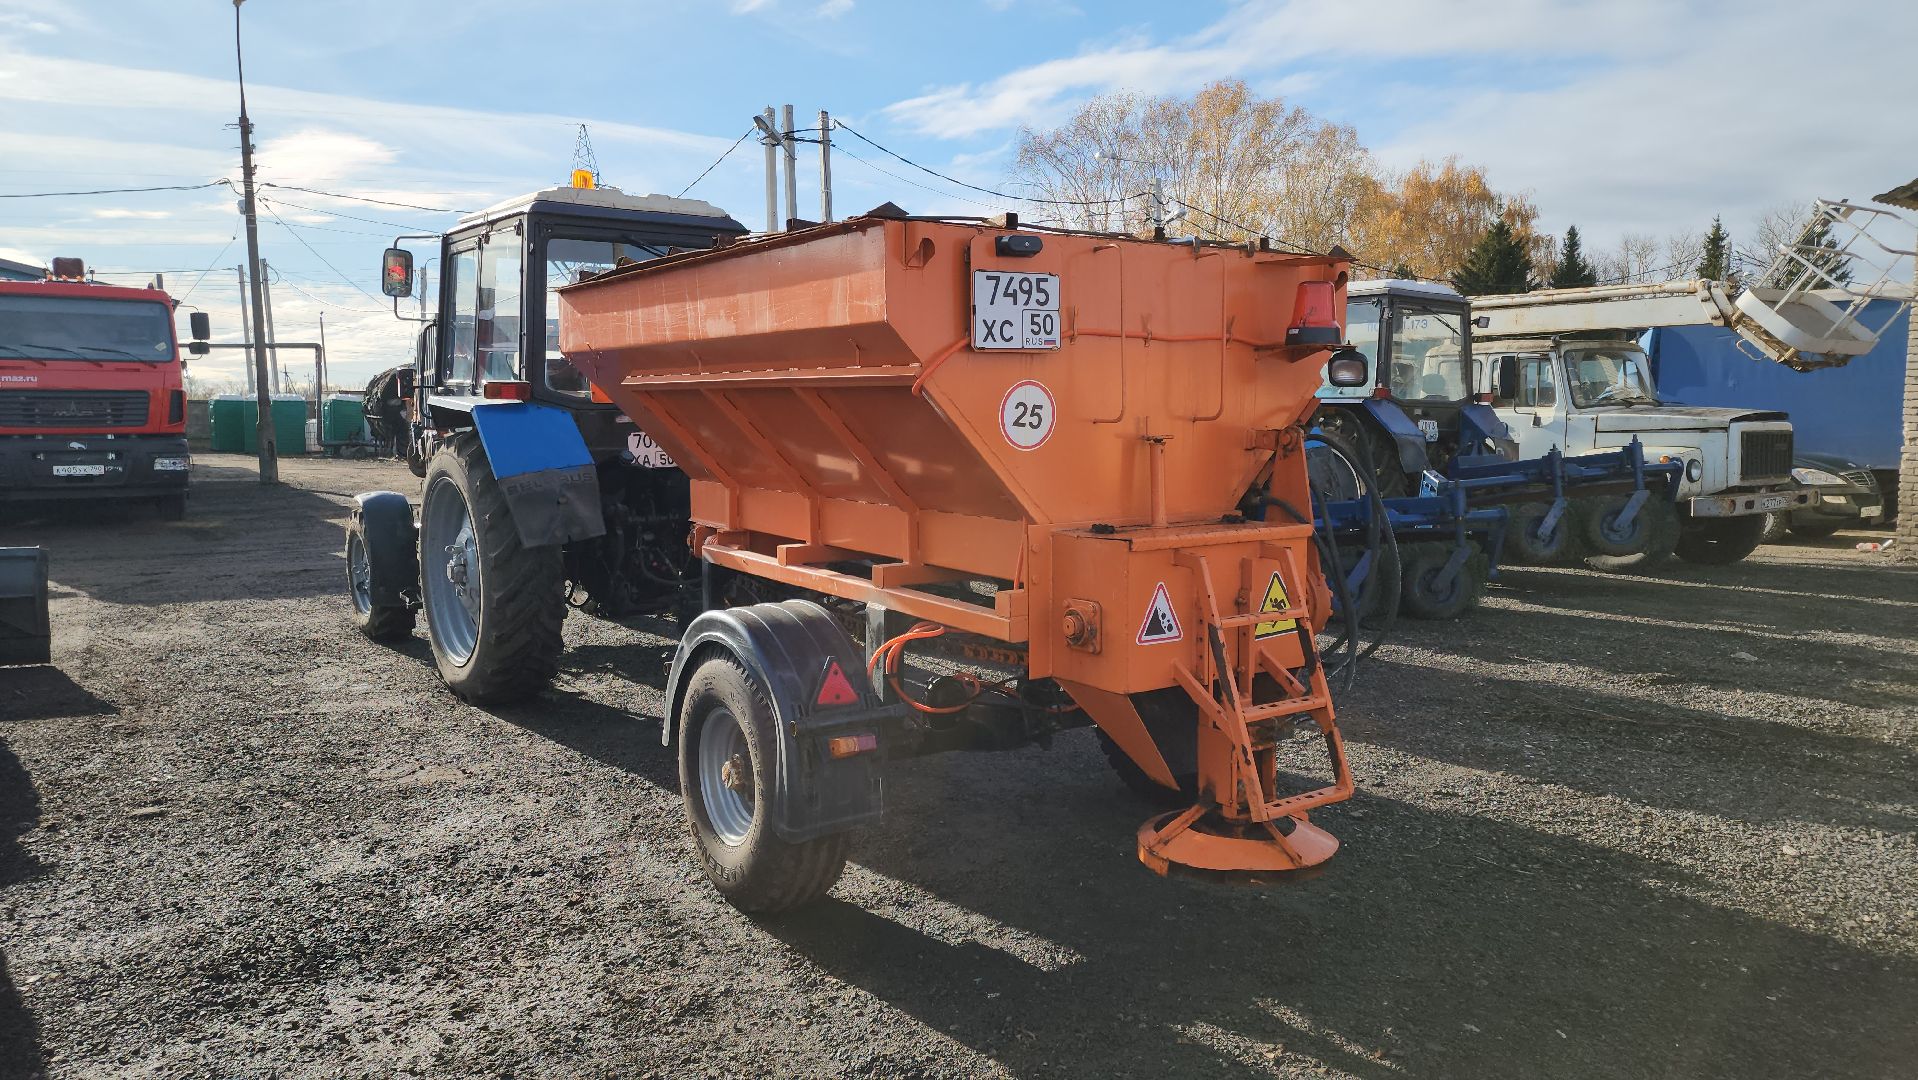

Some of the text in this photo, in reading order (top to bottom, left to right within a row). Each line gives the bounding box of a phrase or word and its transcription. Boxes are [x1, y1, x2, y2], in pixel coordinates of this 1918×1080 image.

[986, 275, 1049, 306] 7495
[1030, 313, 1053, 335] 50
[1025, 337, 1043, 346] RUS
[1012, 401, 1043, 429] 25
[506, 472, 594, 497] BELRUS
